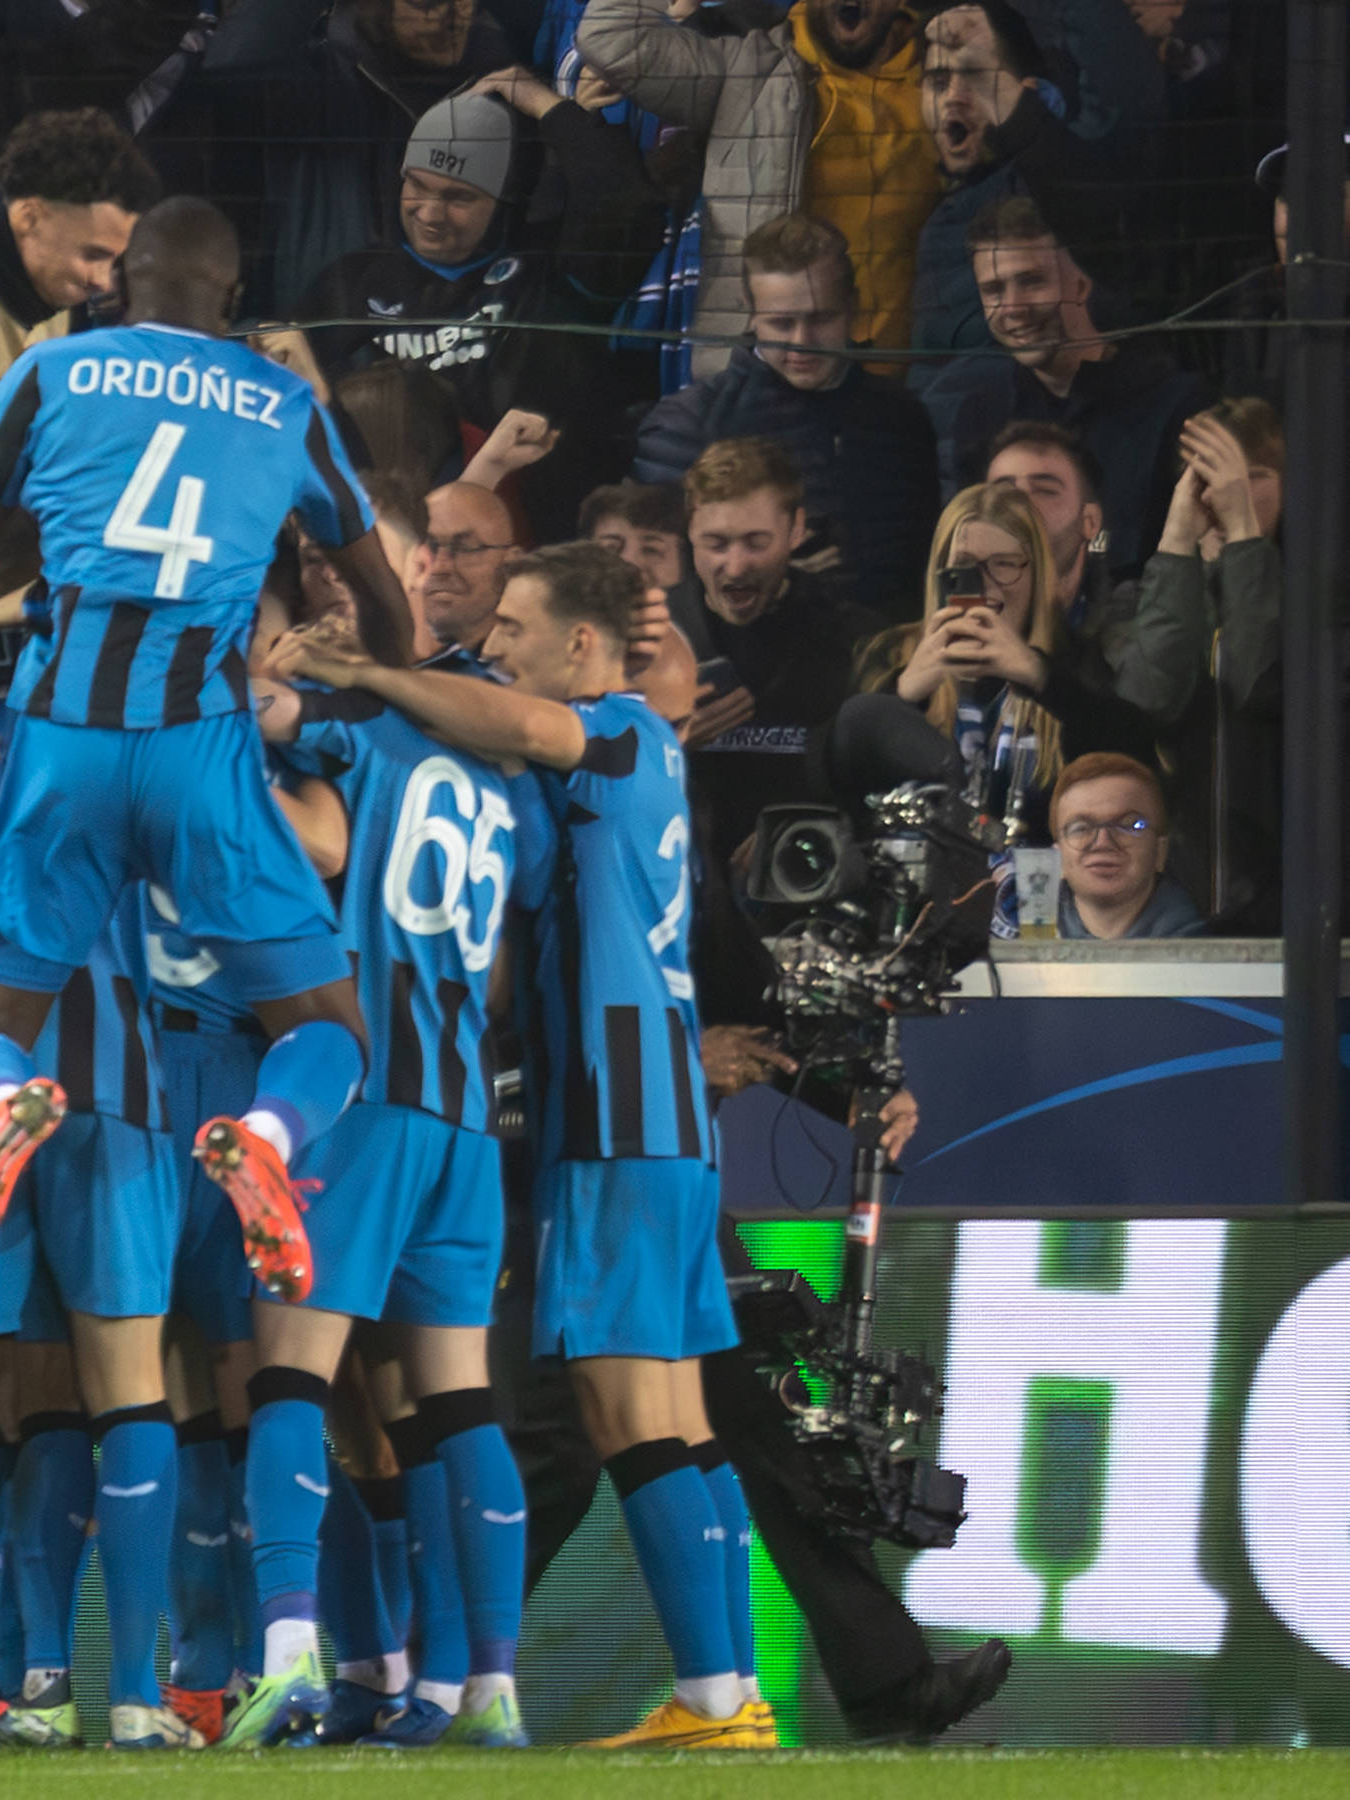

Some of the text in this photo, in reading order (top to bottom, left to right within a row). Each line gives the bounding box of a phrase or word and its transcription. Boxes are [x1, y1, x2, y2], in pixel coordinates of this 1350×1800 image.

[430, 149, 466, 176] 1891
[68, 356, 283, 430] ORDÓÑEZ
[103, 420, 214, 599] 4
[383, 755, 516, 973] 65
